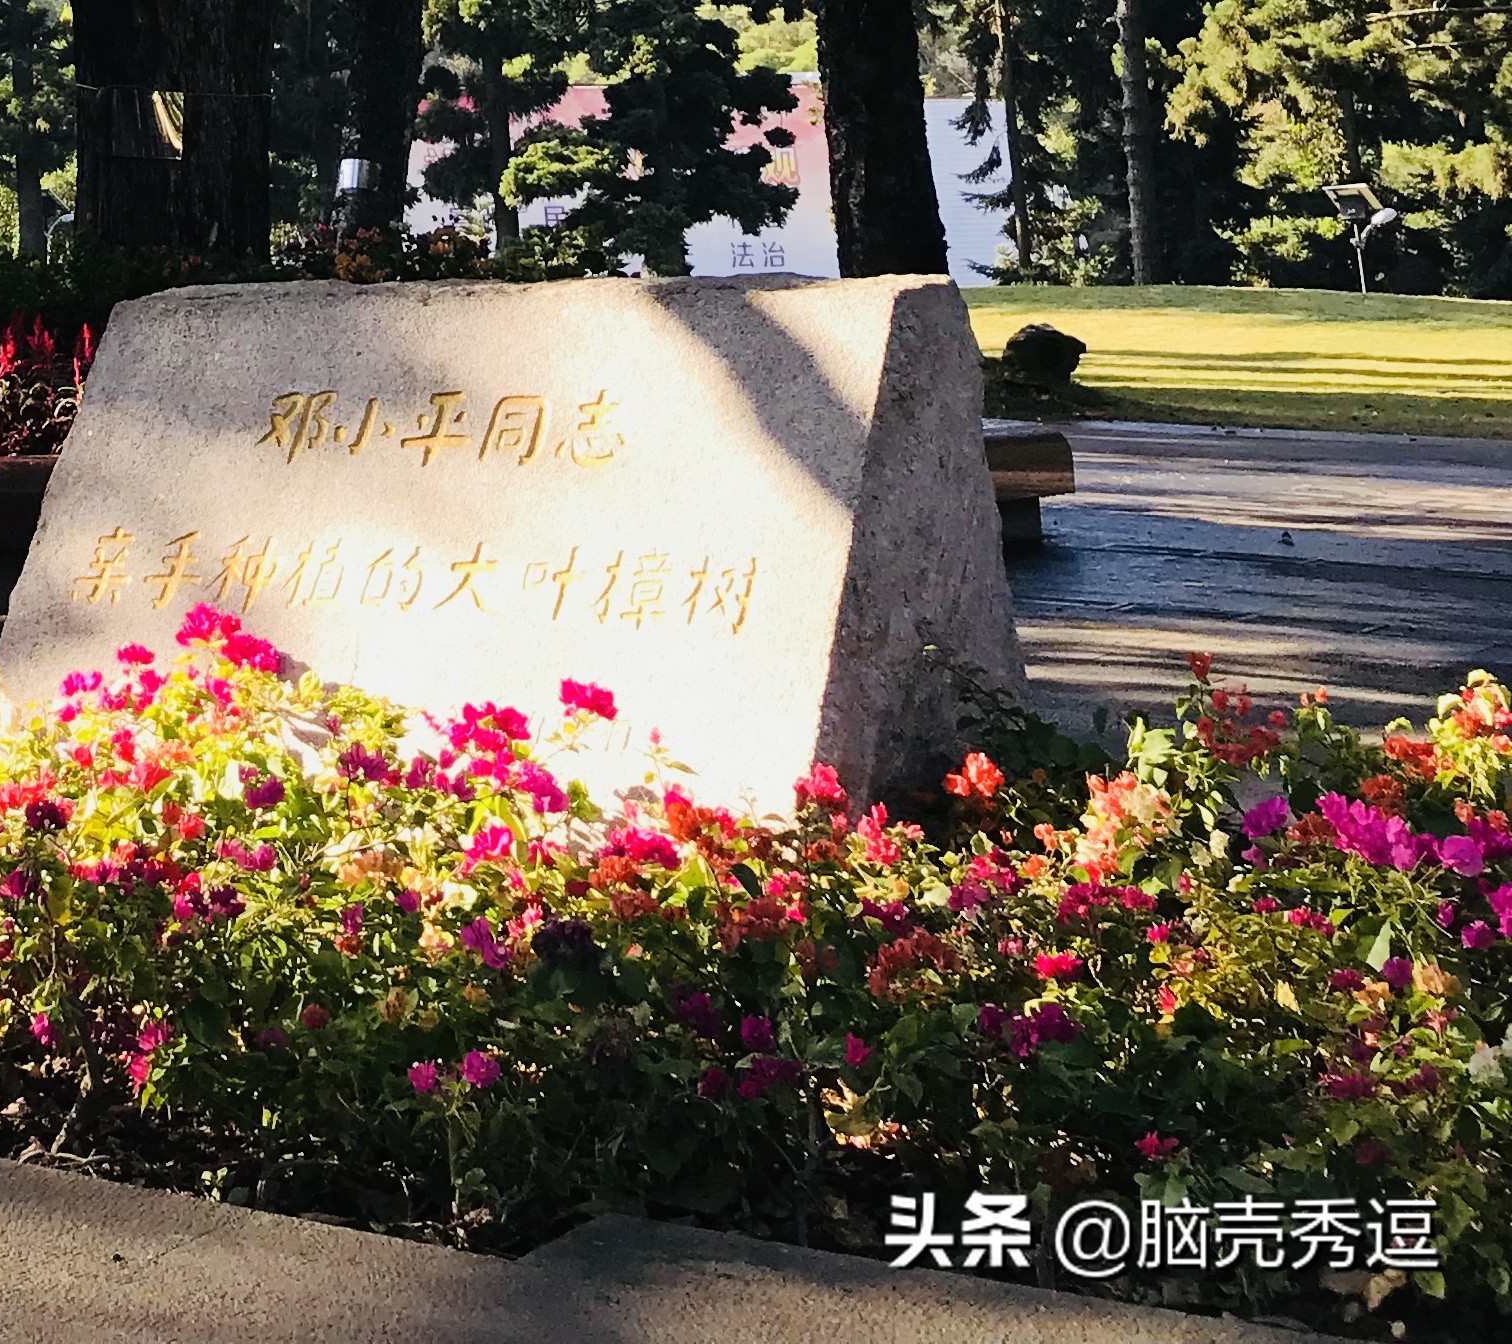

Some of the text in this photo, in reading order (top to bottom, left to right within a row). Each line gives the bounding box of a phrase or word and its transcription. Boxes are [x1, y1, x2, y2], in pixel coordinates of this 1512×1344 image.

[730, 241, 786, 268] 法治
[254, 389, 626, 468] 邓小平同志
[70, 525, 759, 635] 亲手种植的大叶樟树
